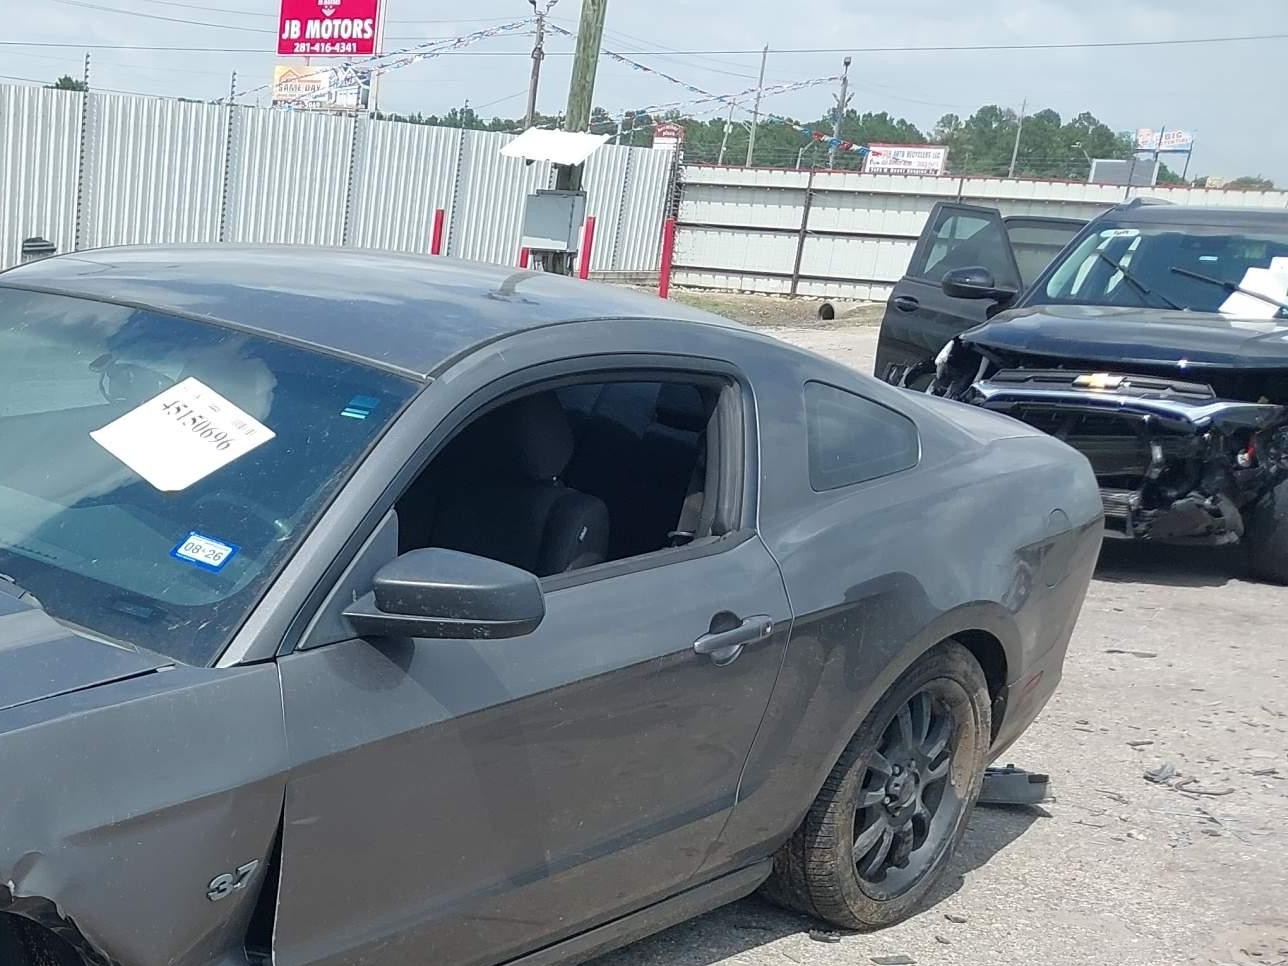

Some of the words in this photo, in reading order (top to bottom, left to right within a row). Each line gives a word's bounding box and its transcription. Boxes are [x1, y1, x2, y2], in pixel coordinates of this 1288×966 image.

[282, 19, 301, 39] JB
[305, 18, 373, 39] MOTORS
[293, 42, 357, 53] 281-416-4341
[161, 400, 232, 451] 45150696
